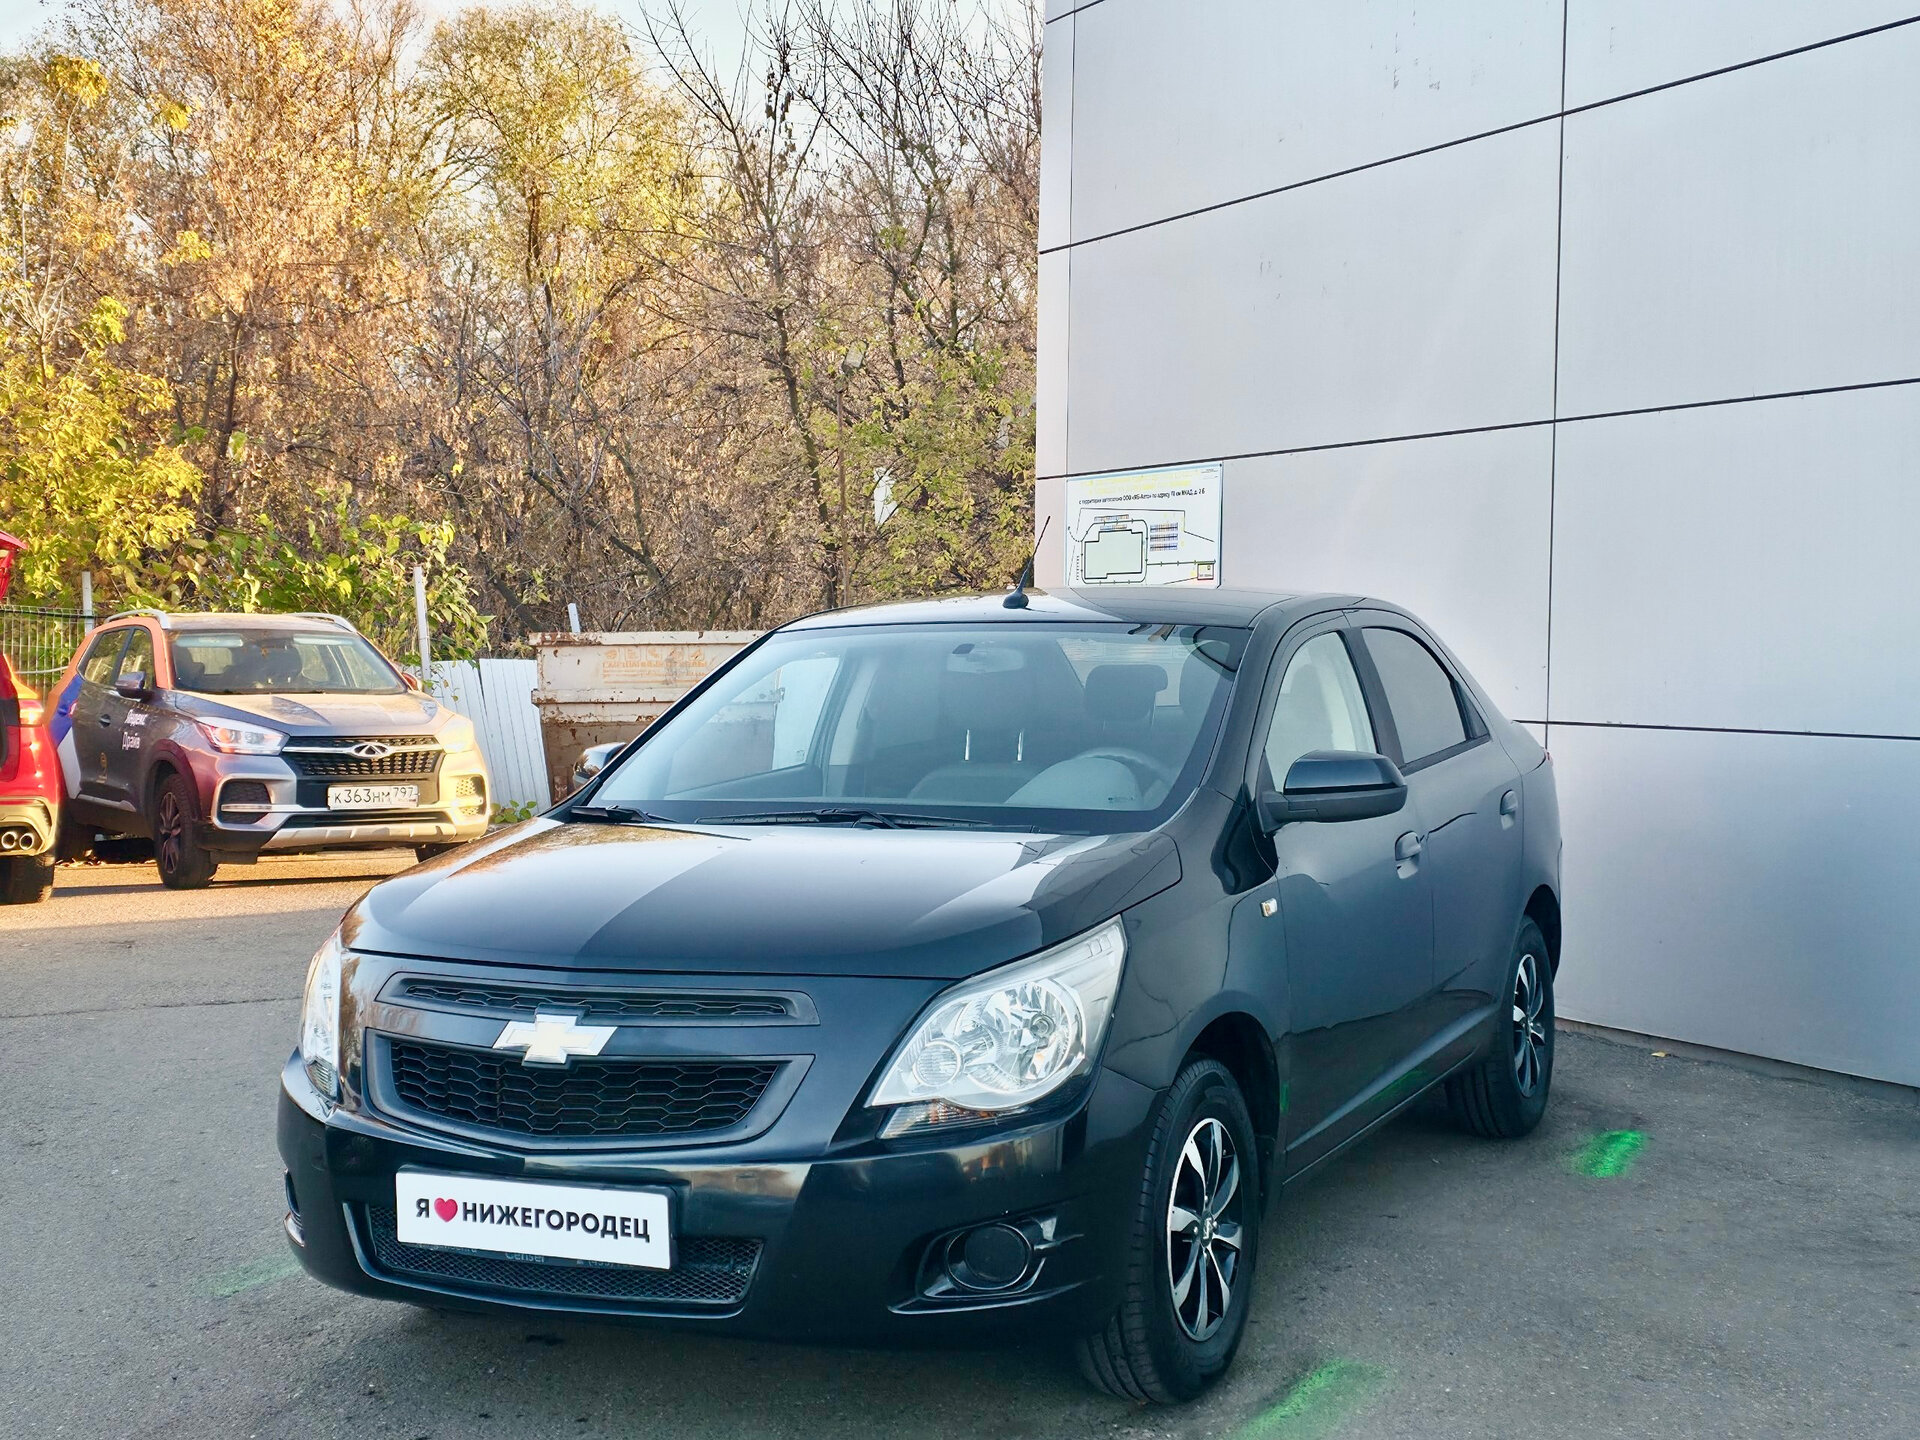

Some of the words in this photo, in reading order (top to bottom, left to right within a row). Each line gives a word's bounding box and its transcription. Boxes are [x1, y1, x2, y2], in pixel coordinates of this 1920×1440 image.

[124, 709, 148, 726] Яндекс
[122, 731, 140, 750] Драйв
[416, 1197, 430, 1218] Я
[462, 1201, 651, 1243] НИЖЕГОРОДЕЦ
